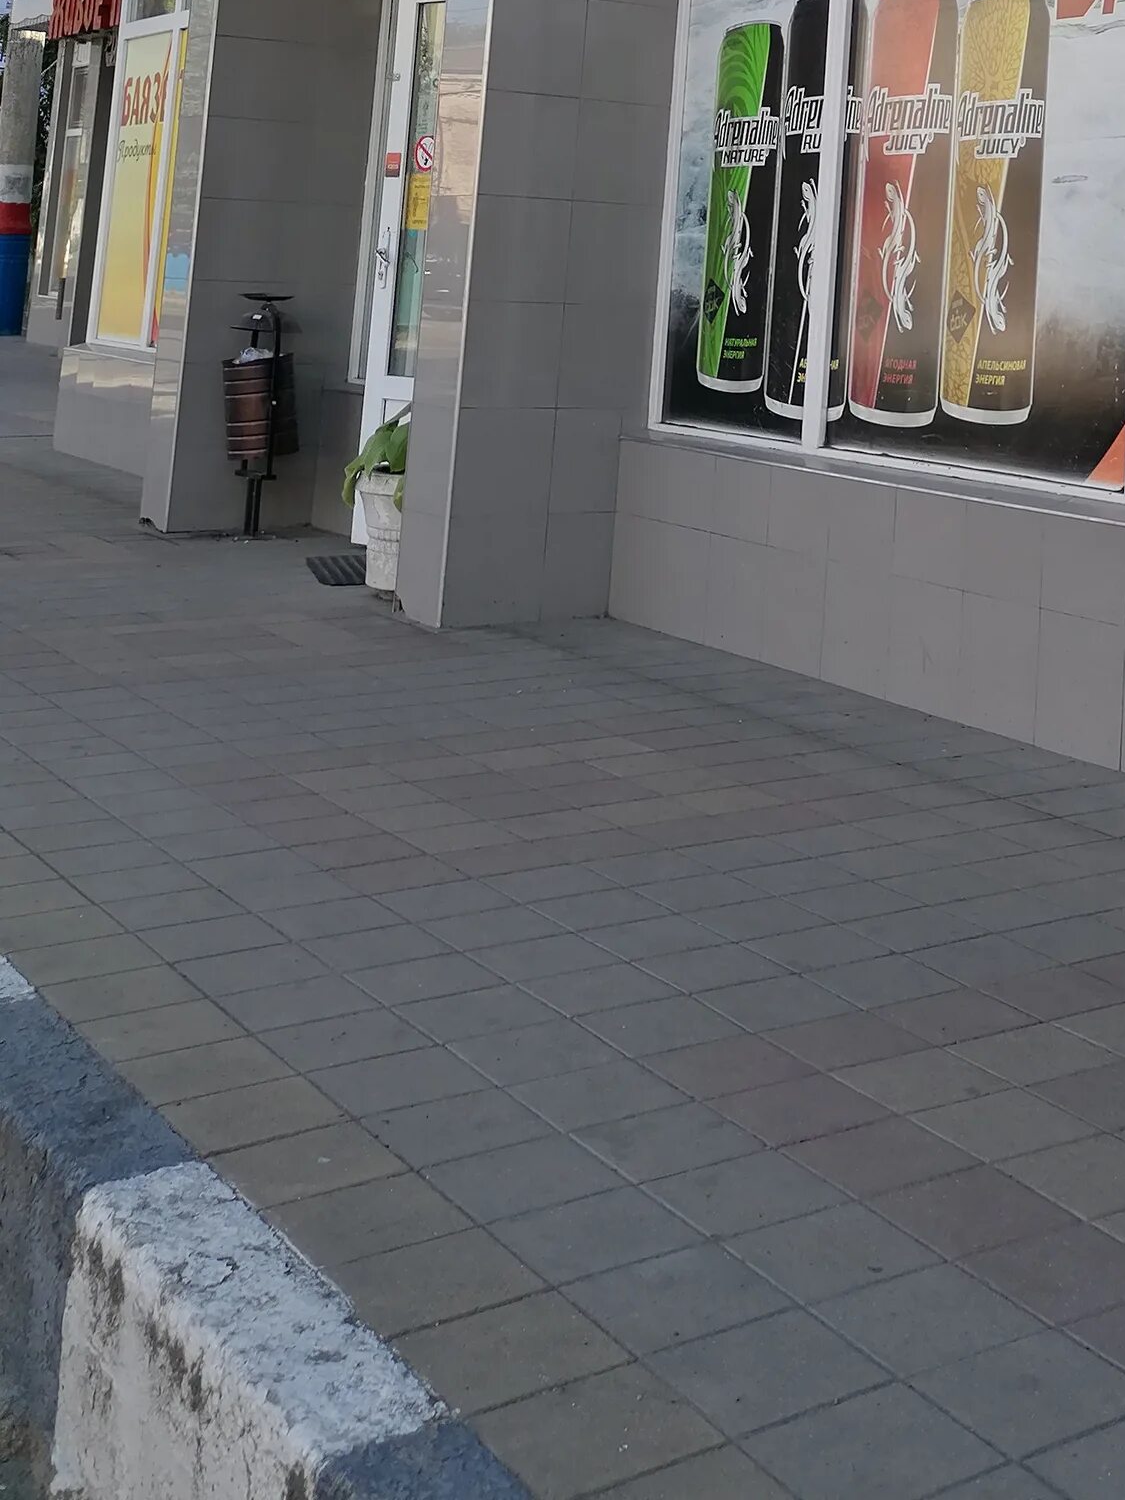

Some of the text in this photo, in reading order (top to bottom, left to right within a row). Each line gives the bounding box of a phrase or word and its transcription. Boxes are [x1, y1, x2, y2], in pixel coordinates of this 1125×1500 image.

[866, 86, 951, 134] Adrenaline
[957, 91, 1044, 138] Adrenaline
[714, 108, 778, 149] Adrenaline
[886, 133, 928, 151] JUICY
[723, 148, 764, 164] NATURE
[977, 137, 1020, 156] JUICY
